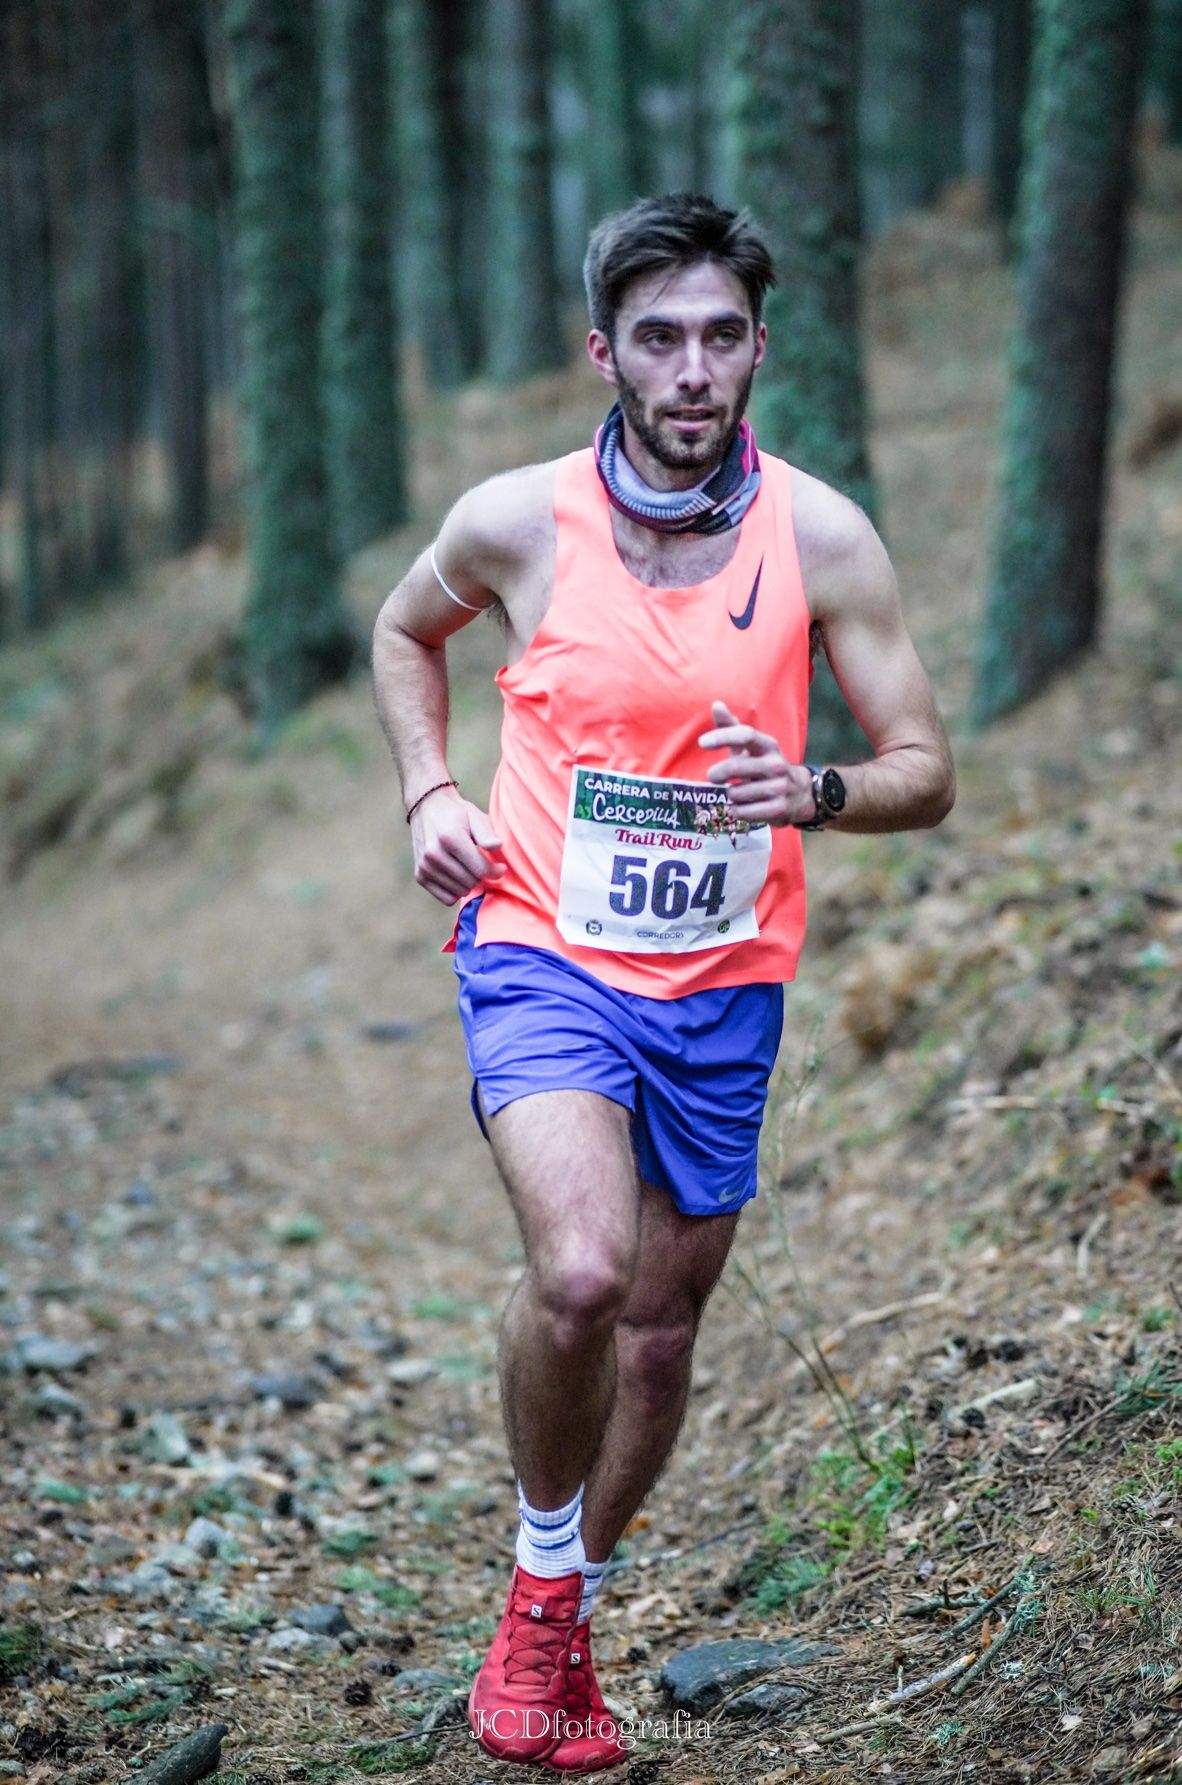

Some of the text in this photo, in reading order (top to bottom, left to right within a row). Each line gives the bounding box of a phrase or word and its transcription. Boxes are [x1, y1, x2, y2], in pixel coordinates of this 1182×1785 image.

[584, 778, 731, 805] CARRERA DE NAVIDA
[615, 828, 703, 851] Trail Run
[609, 854, 728, 920] 564
